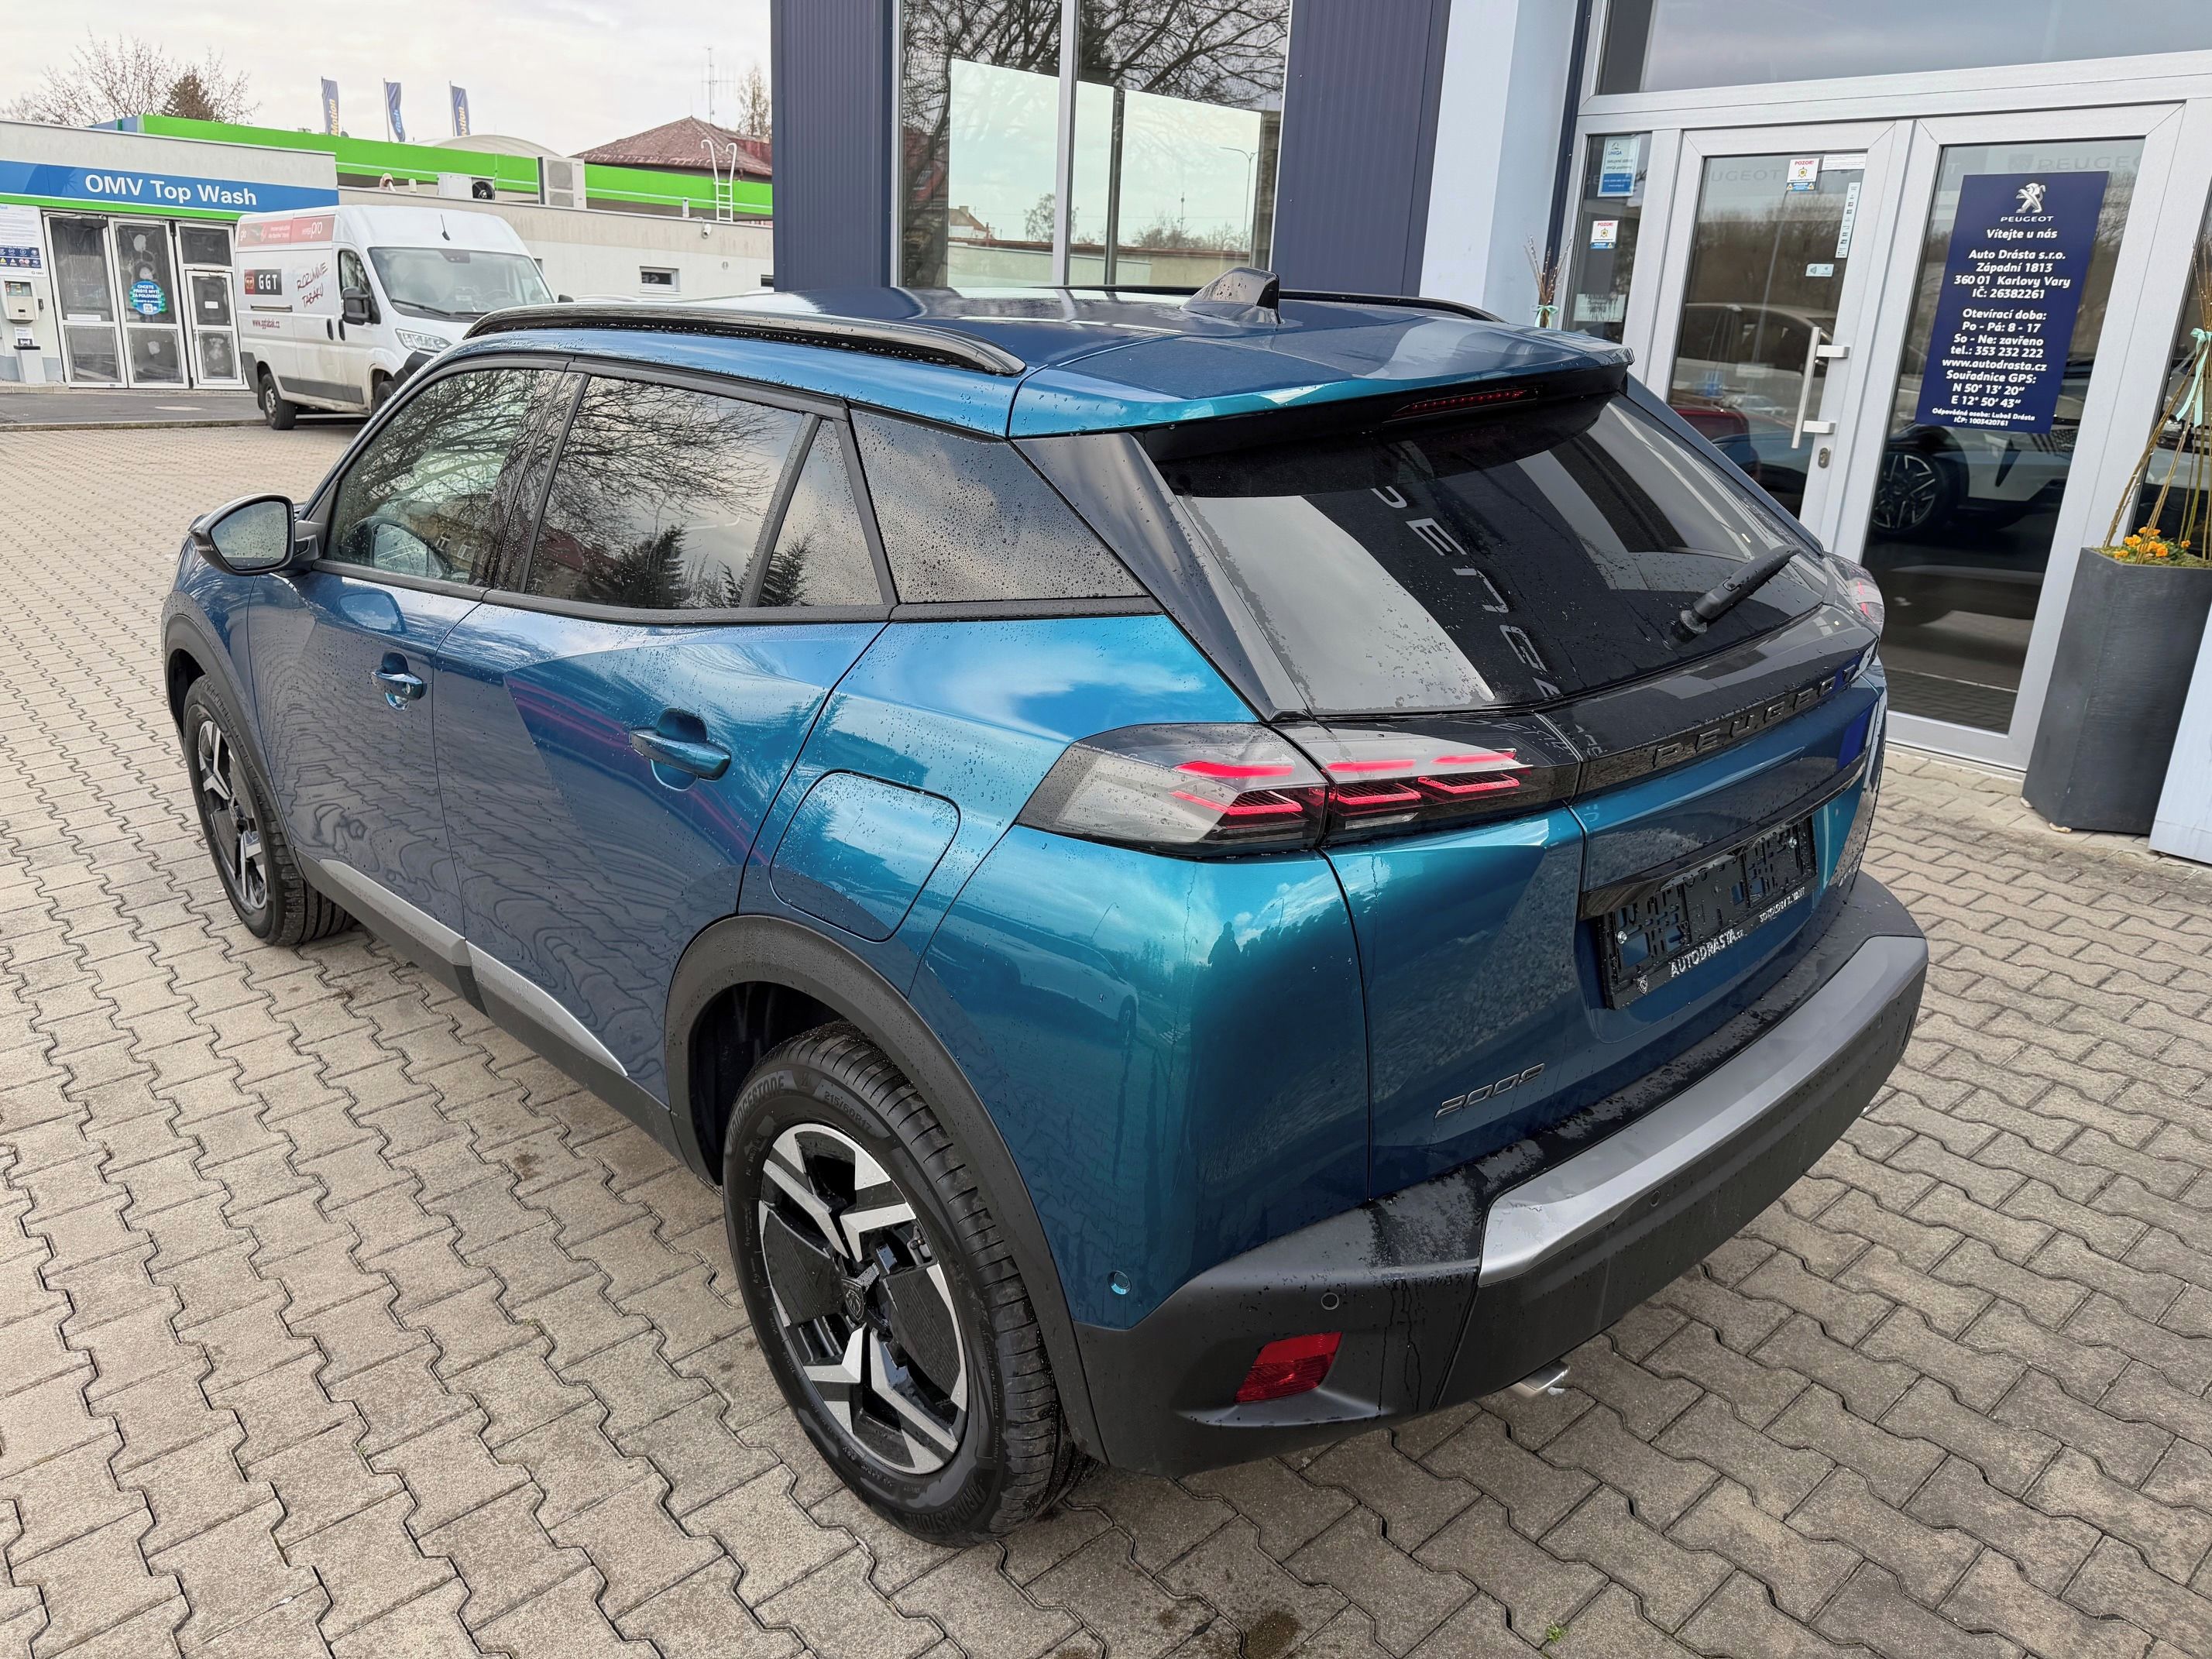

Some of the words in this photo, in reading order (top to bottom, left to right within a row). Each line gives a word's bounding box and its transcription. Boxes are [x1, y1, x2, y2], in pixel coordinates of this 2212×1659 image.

[85, 174, 143, 196] OMV
[149, 180, 191, 204] Top
[197, 184, 257, 205] Wash
[1987, 228, 2024, 240] Vítejte
[2037, 228, 2057, 238] nás
[1969, 249, 1995, 259] Auto
[1998, 249, 2035, 259] Drásta
[1977, 263, 2022, 273] Západní
[2026, 263, 2052, 273] 1813
[258, 274, 277, 290] GGT
[1997, 276, 2040, 287] Karlovy
[2045, 276, 2070, 288] Vary
[1973, 287, 1987, 297] IČ:
[1990, 289, 2045, 298] 26382261
[1963, 308, 2013, 318] Otevírací
[2015, 310, 2046, 320] doba:
[1963, 321, 1977, 330] Po
[1987, 322, 2005, 331] Pá:
[2008, 323, 2015, 331] 8
[2028, 324, 2041, 332] 17
[1954, 334, 1967, 342] So
[1978, 335, 1997, 344] Ne:
[1999, 336, 2043, 346] zavřeno
[1951, 345, 1972, 354] tel.:
[1975, 346, 1996, 356] 353
[1998, 347, 2019, 356] 232
[2021, 349, 2043, 358] 222
[1942, 359, 2047, 371] www.autodrasta.cz
[1946, 370, 2005, 383] Souřadnice
[2008, 373, 2036, 383] GPS:
[1653, 664, 1856, 768] PEUGEOT
